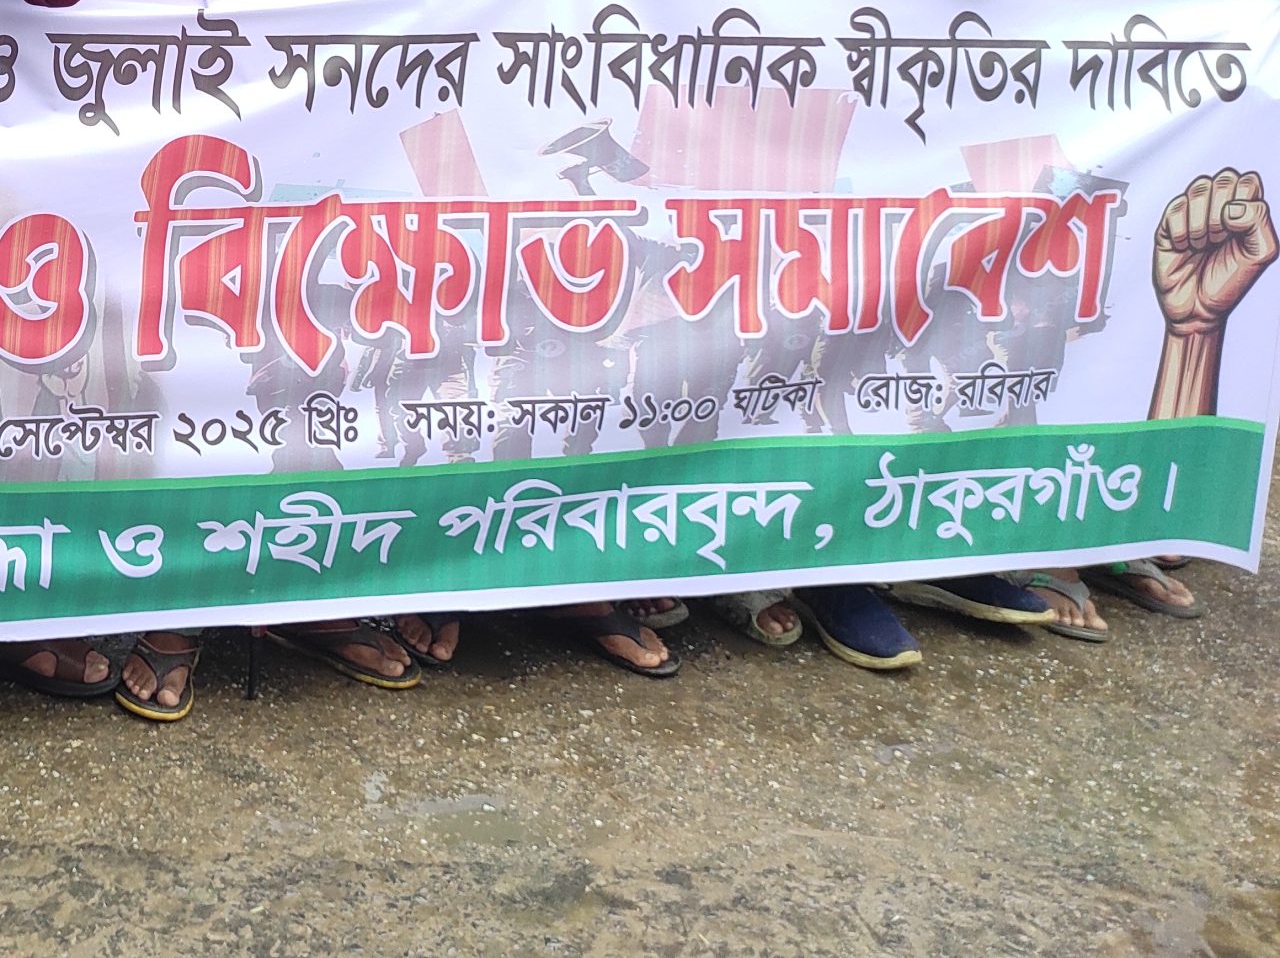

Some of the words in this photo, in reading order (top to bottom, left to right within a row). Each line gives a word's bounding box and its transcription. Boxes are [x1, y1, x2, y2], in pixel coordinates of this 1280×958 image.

[46, 9, 250, 135] জুলাই
[267, 32, 477, 122] সনদের
[493, 4, 824, 113] সাংবিধানিক
[835, 7, 1050, 144] স্বীকৃতির
[1062, 14, 1252, 113] দাবিতে
[133, 133, 646, 375] বিক্ষোভ
[667, 188, 1123, 345] সমাবেশ
[174, 412, 287, 456] ২০২৫
[511, 391, 609, 437] সকাল
[621, 394, 715, 431] ১১:০০
[732, 374, 822, 421] ঘটিকা
[956, 361, 1057, 409] রবিবার
[99, 523, 163, 579] ও
[197, 490, 417, 575] শহীদ
[862, 444, 1142, 545] ঠাকুরগাঁও
